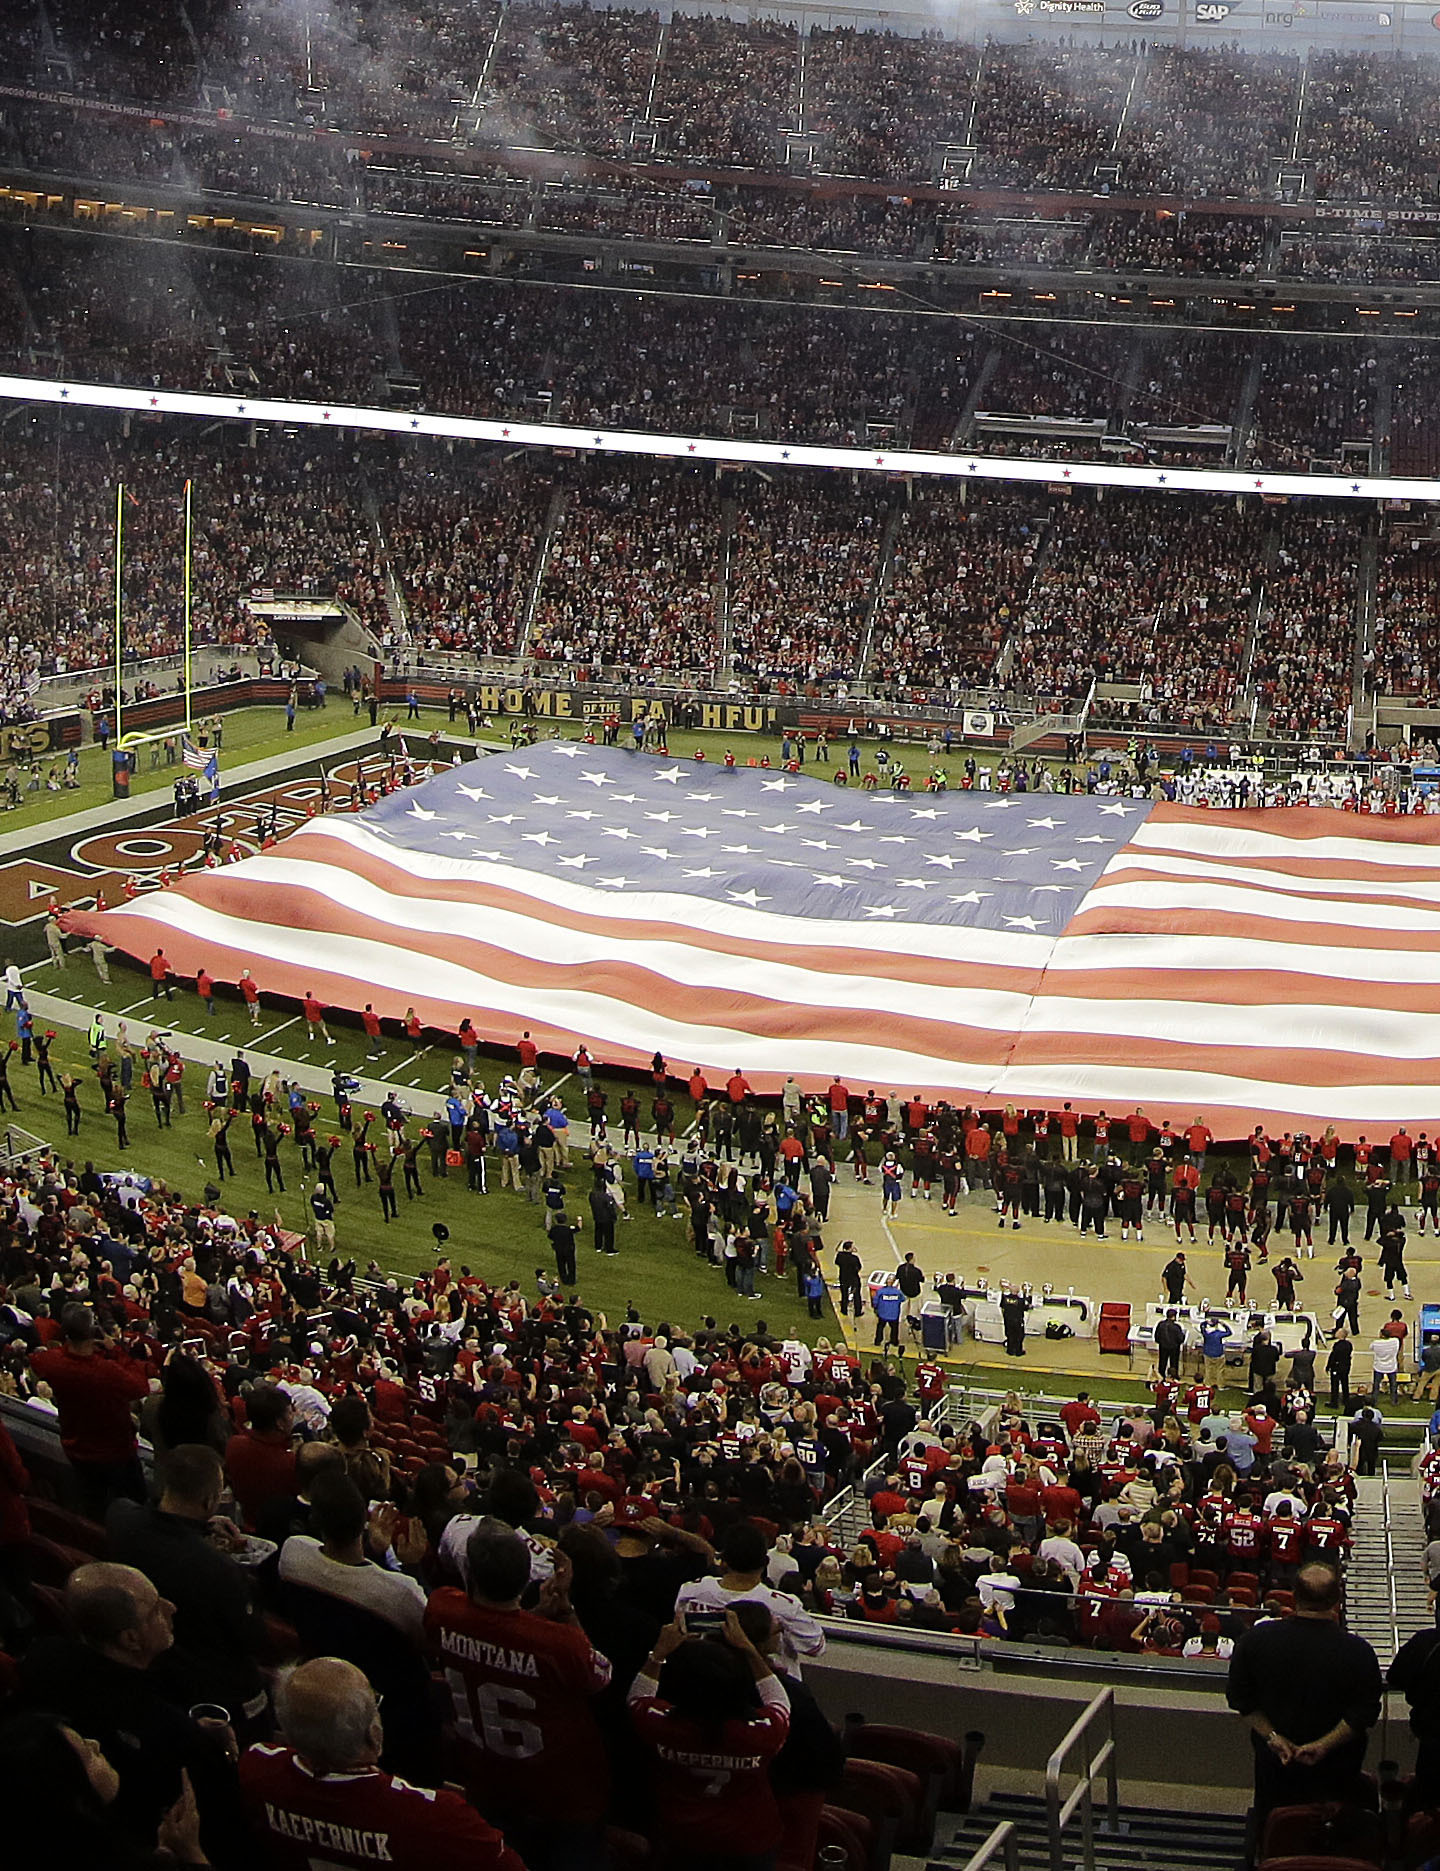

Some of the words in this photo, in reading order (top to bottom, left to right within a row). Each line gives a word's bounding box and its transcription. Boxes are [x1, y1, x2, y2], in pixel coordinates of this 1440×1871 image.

[1040, 0, 1073, 13] Dignity
[1073, 0, 1105, 13] Health
[1196, 3, 1230, 22] SAP
[1266, 10, 1294, 28] nrg
[1315, 207, 1383, 219] 5-TIME
[480, 685, 572, 718] HOME
[598, 703, 622, 716] THE
[831, 1365, 850, 1380] 85
[923, 1375, 934, 1390] 7
[908, 1471, 922, 1489] 8
[1231, 1527, 1255, 1548] 52
[1276, 1532, 1290, 1550] 7
[1316, 1532, 1329, 1548] 7
[1089, 1598, 1102, 1617] 7
[439, 1624, 541, 1680] MONTANA
[444, 1664, 546, 1760] 16
[656, 1742, 762, 1770] KAEPERNICK
[686, 1767, 733, 1799] 7
[264, 1800, 394, 1864] KAEPERNICK
